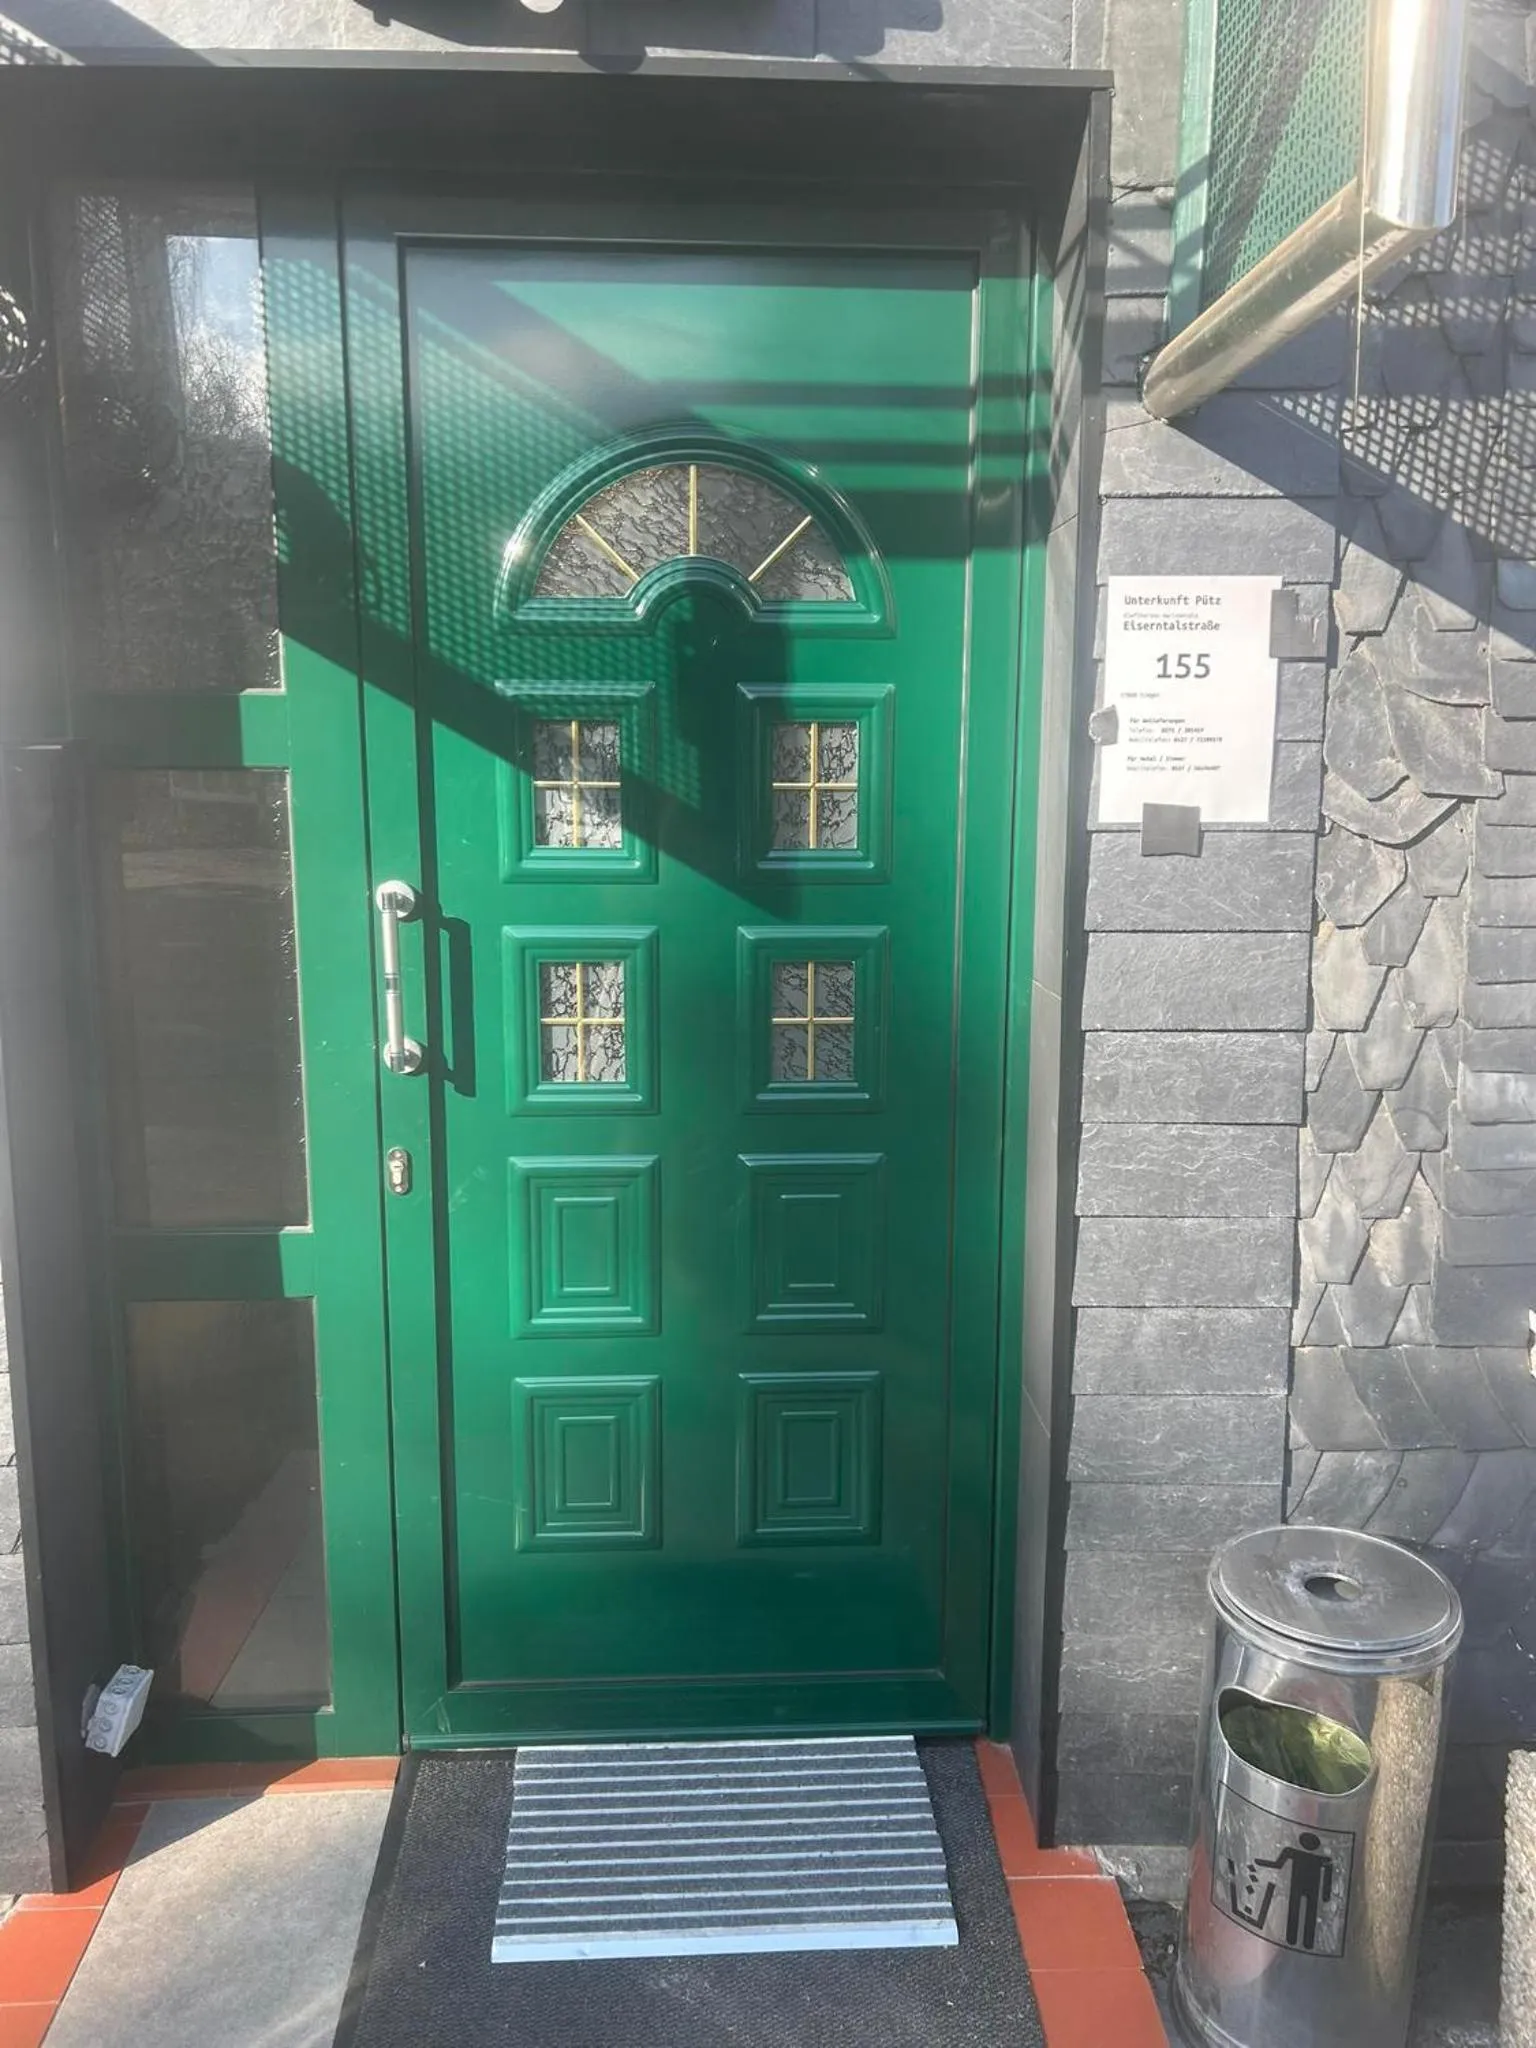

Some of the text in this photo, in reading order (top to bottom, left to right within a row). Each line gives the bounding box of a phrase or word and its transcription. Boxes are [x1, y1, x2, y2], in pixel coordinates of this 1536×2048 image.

[1125, 594, 1221, 606] Unterkunft Pütz
[1123, 620, 1220, 631] Eiserntalstraße
[1156, 653, 1211, 679] 155
